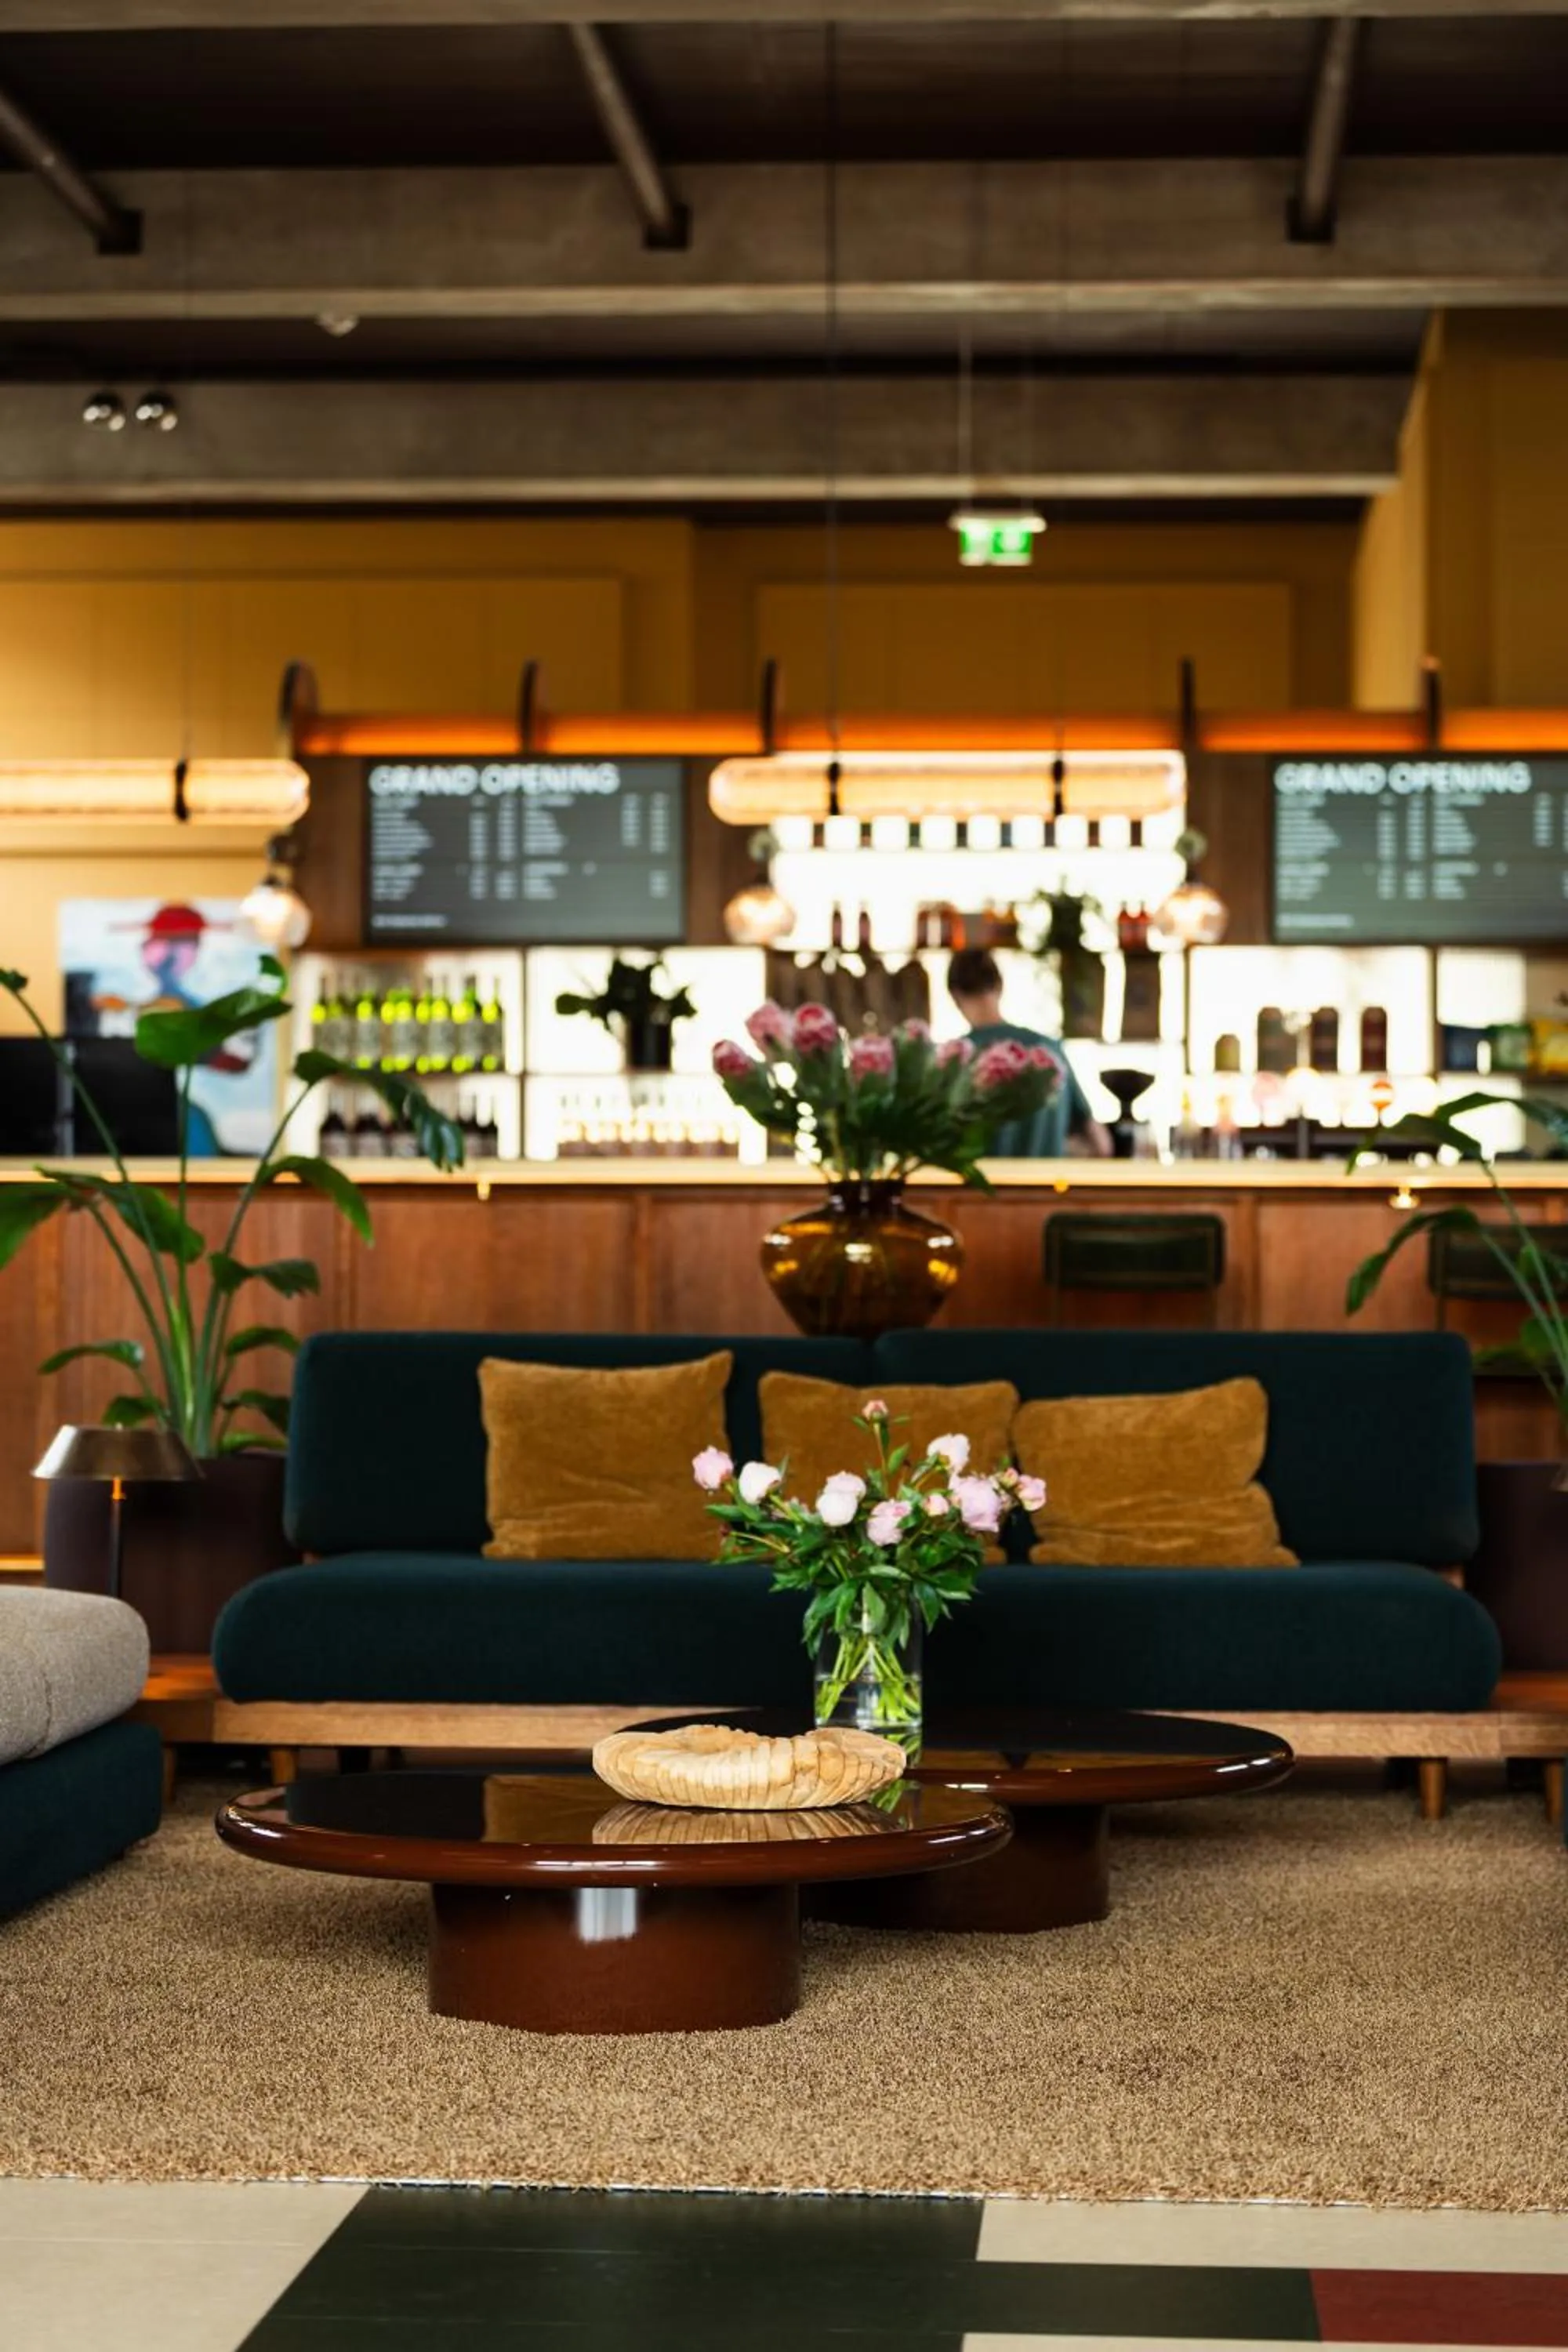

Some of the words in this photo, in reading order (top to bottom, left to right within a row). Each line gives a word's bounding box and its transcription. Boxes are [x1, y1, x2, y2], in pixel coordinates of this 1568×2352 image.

[370, 765, 477, 794] GRAND
[481, 764, 619, 793] OPENING
[1275, 763, 1385, 793] GRAND
[1388, 761, 1530, 793] OPENING
